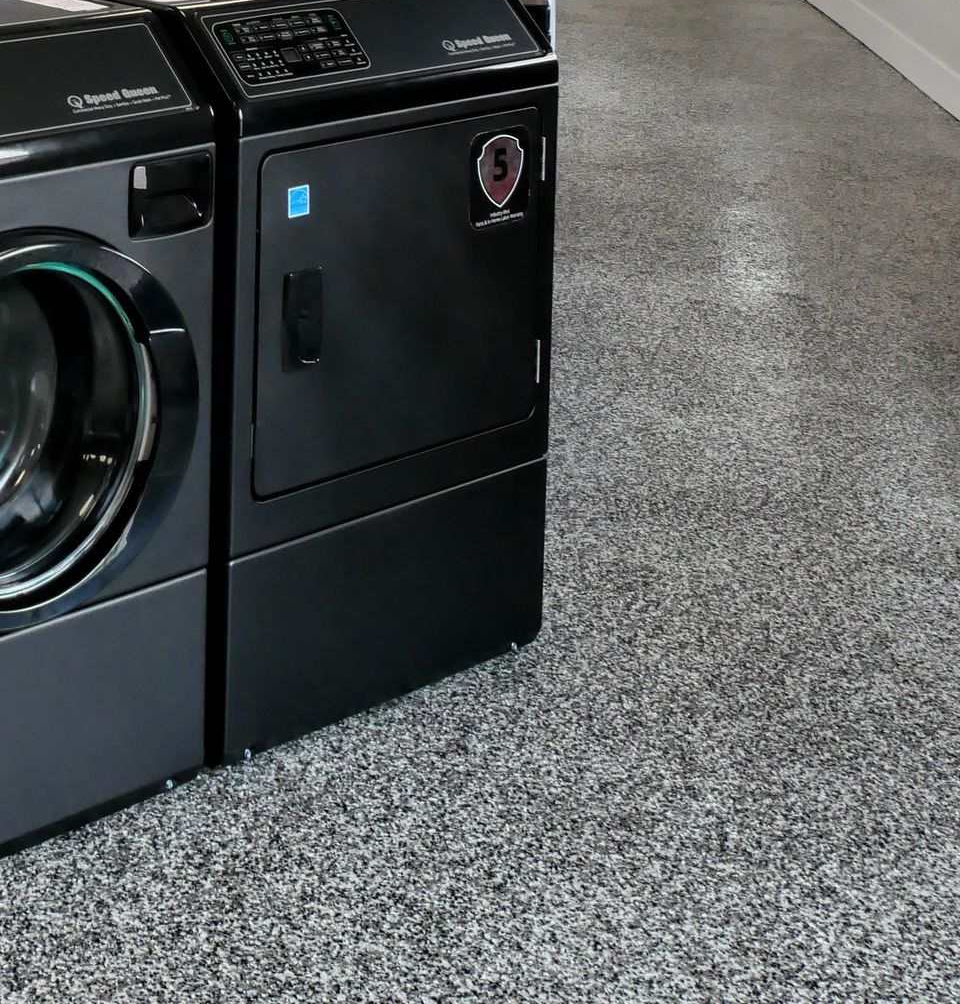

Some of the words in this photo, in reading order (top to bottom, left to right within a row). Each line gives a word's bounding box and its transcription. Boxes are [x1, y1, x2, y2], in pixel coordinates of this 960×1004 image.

[454, 36, 483, 49] Speed
[483, 33, 512, 44] Queen
[83, 90, 121, 105] Speed
[121, 86, 159, 98] Queen
[493, 147, 508, 181] 5
